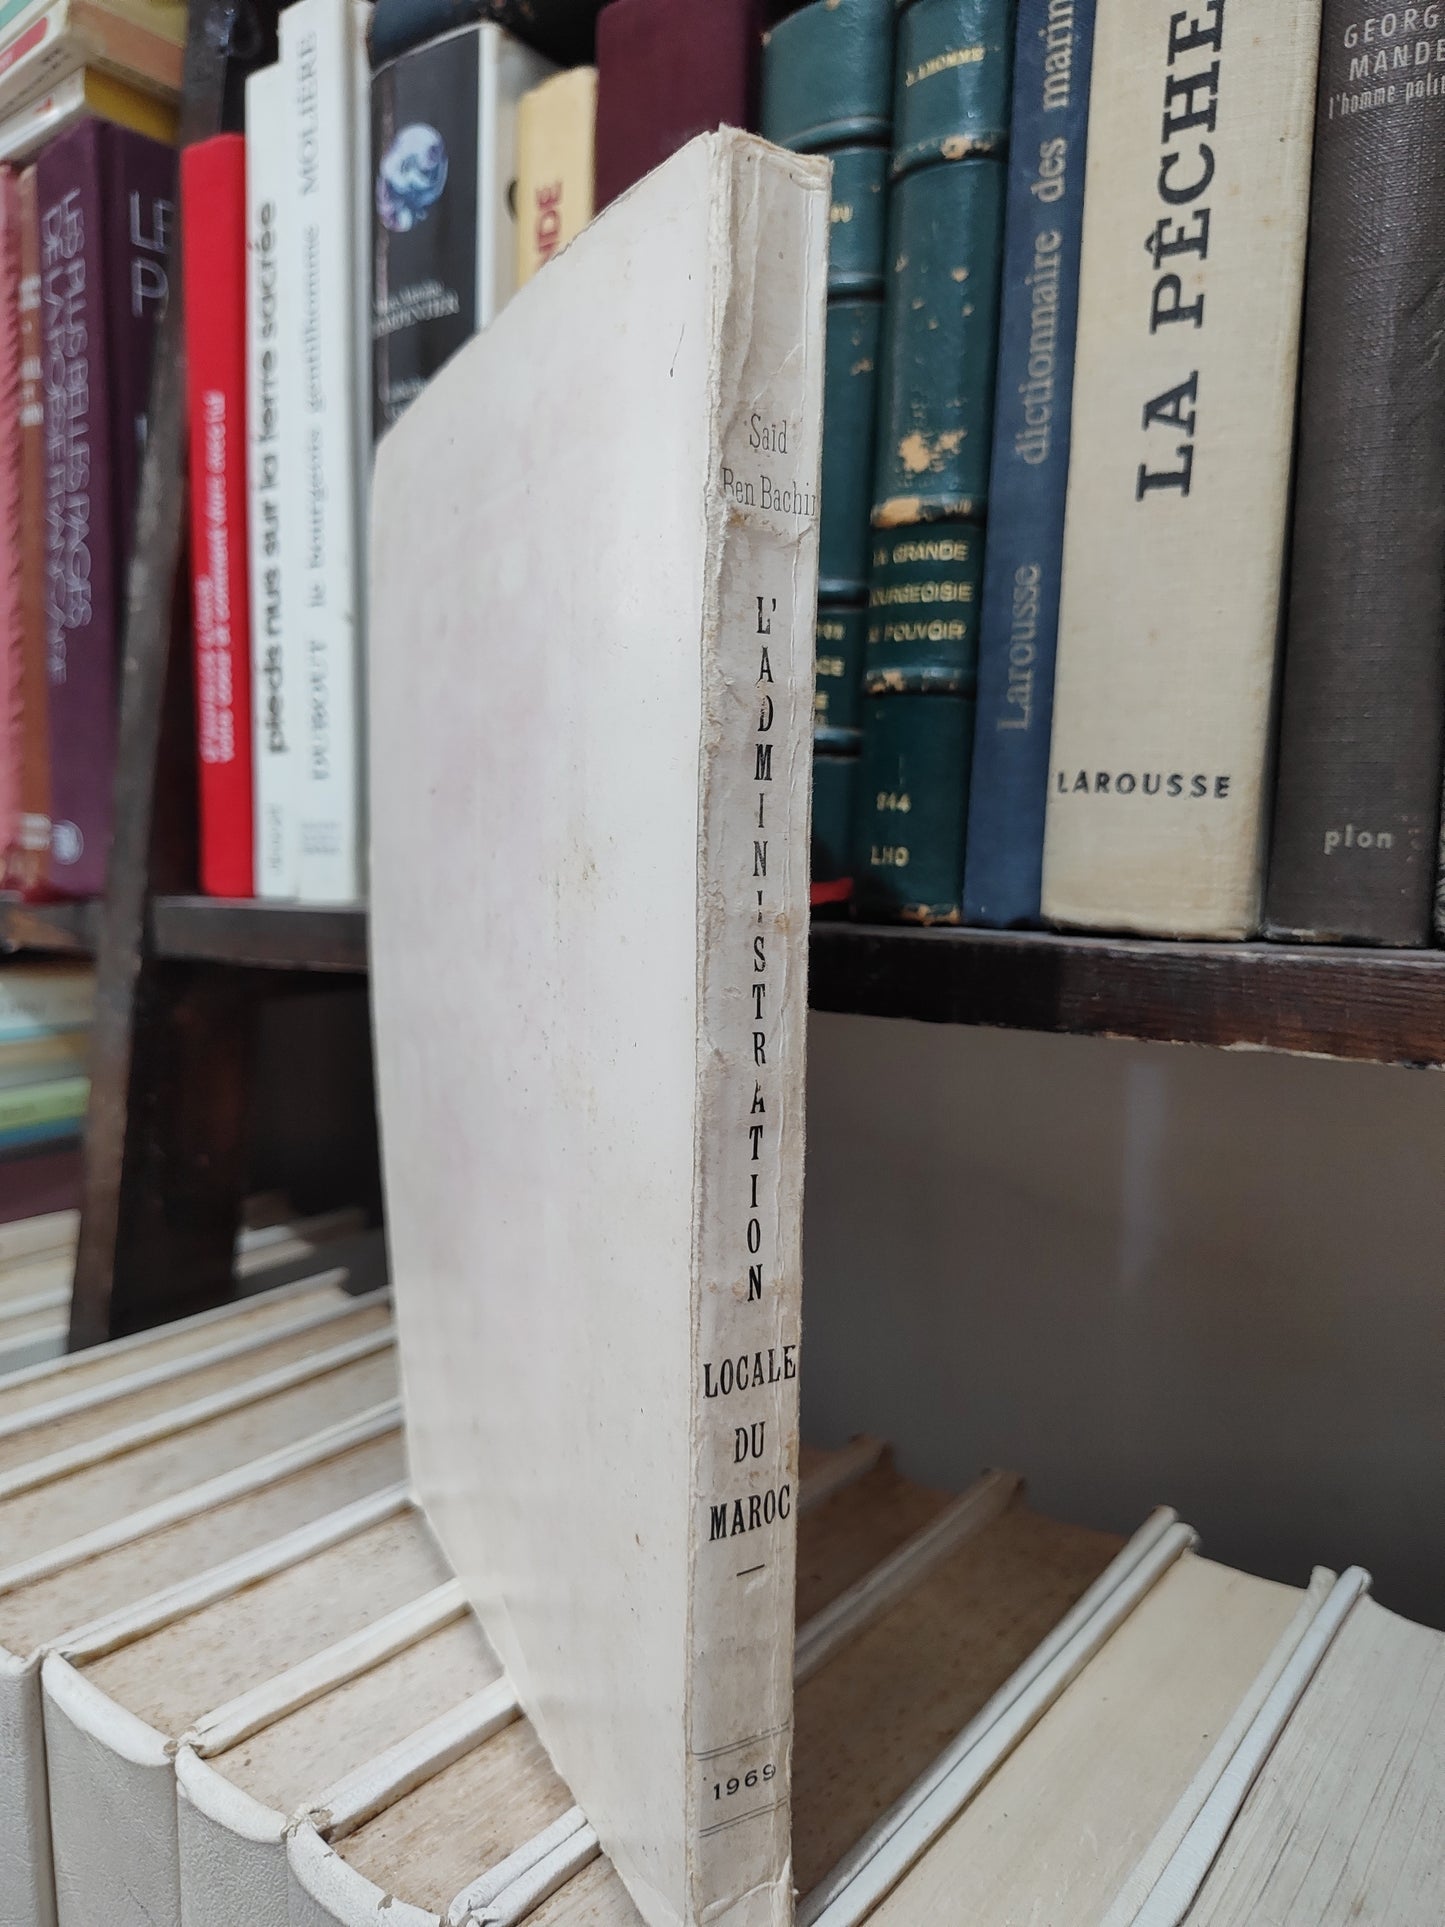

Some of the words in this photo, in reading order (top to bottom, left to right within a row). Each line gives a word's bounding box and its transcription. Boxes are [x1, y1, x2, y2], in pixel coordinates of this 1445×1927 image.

[1328, 85, 1396, 119] l'homme
[1030, 136, 1069, 203] des
[1144, 0, 1225, 336] PÊCHE
[252, 202, 276, 341] sacrée
[1015, 229, 1063, 466] dictionnaire
[256, 350, 278, 442] terre
[1136, 370, 1199, 502] LA
[258, 455, 278, 491] la
[721, 466, 756, 507] Ben
[262, 501, 280, 558] sur
[893, 539, 969, 564] GRANDE
[262, 568, 281, 638] nus
[884, 618, 968, 643] POUVOIR
[997, 563, 1042, 731] Larousse
[264, 645, 287, 754] pieds
[1057, 770, 1232, 800] LAROUSSE
[1324, 824, 1393, 855] plon
[703, 1344, 797, 1399] LOCALE
[733, 1420, 766, 1464] DU
[708, 1483, 792, 1542] MAROC
[713, 1763, 777, 1801] 1969
